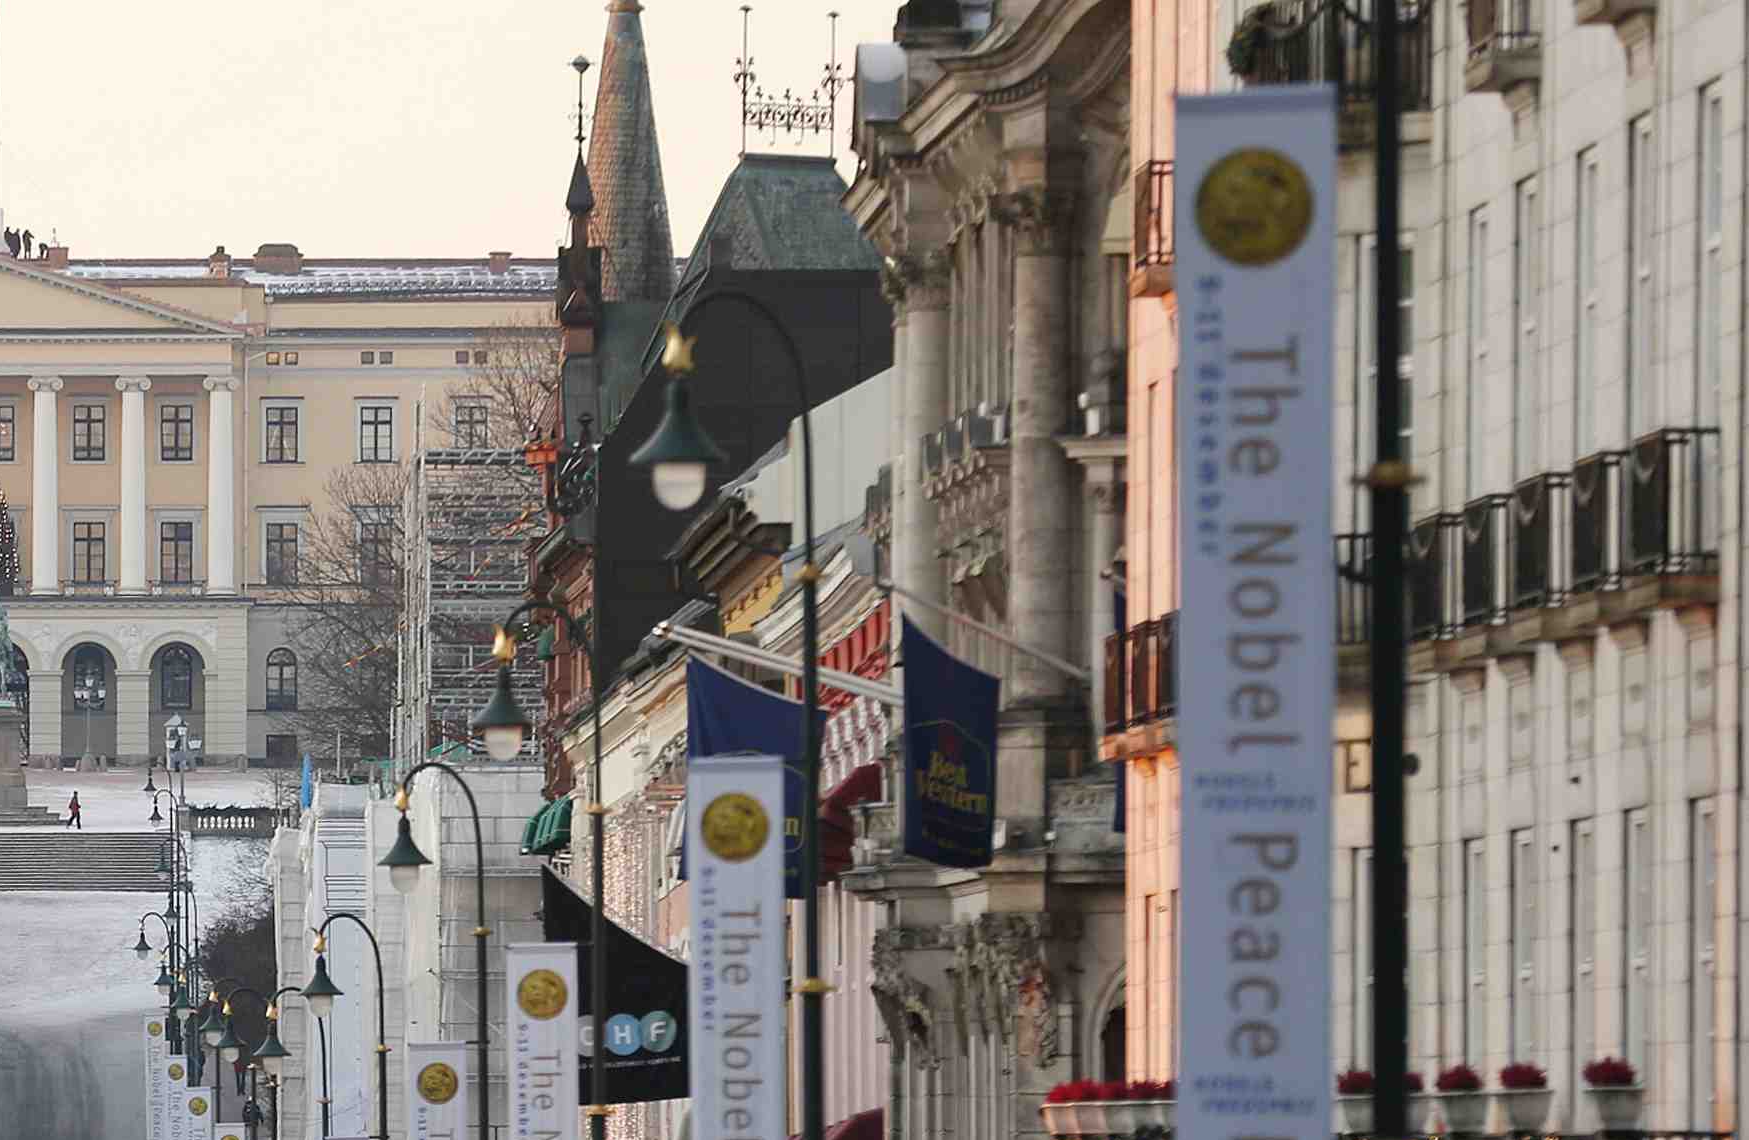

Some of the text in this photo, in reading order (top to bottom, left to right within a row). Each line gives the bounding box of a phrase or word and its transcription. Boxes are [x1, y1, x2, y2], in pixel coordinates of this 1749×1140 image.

[1228, 336, 1301, 476] The
[1228, 521, 1304, 757] Nobel
[720, 901, 764, 987] The
[1228, 833, 1300, 1059] Peace
[532, 1049, 562, 1111] The
